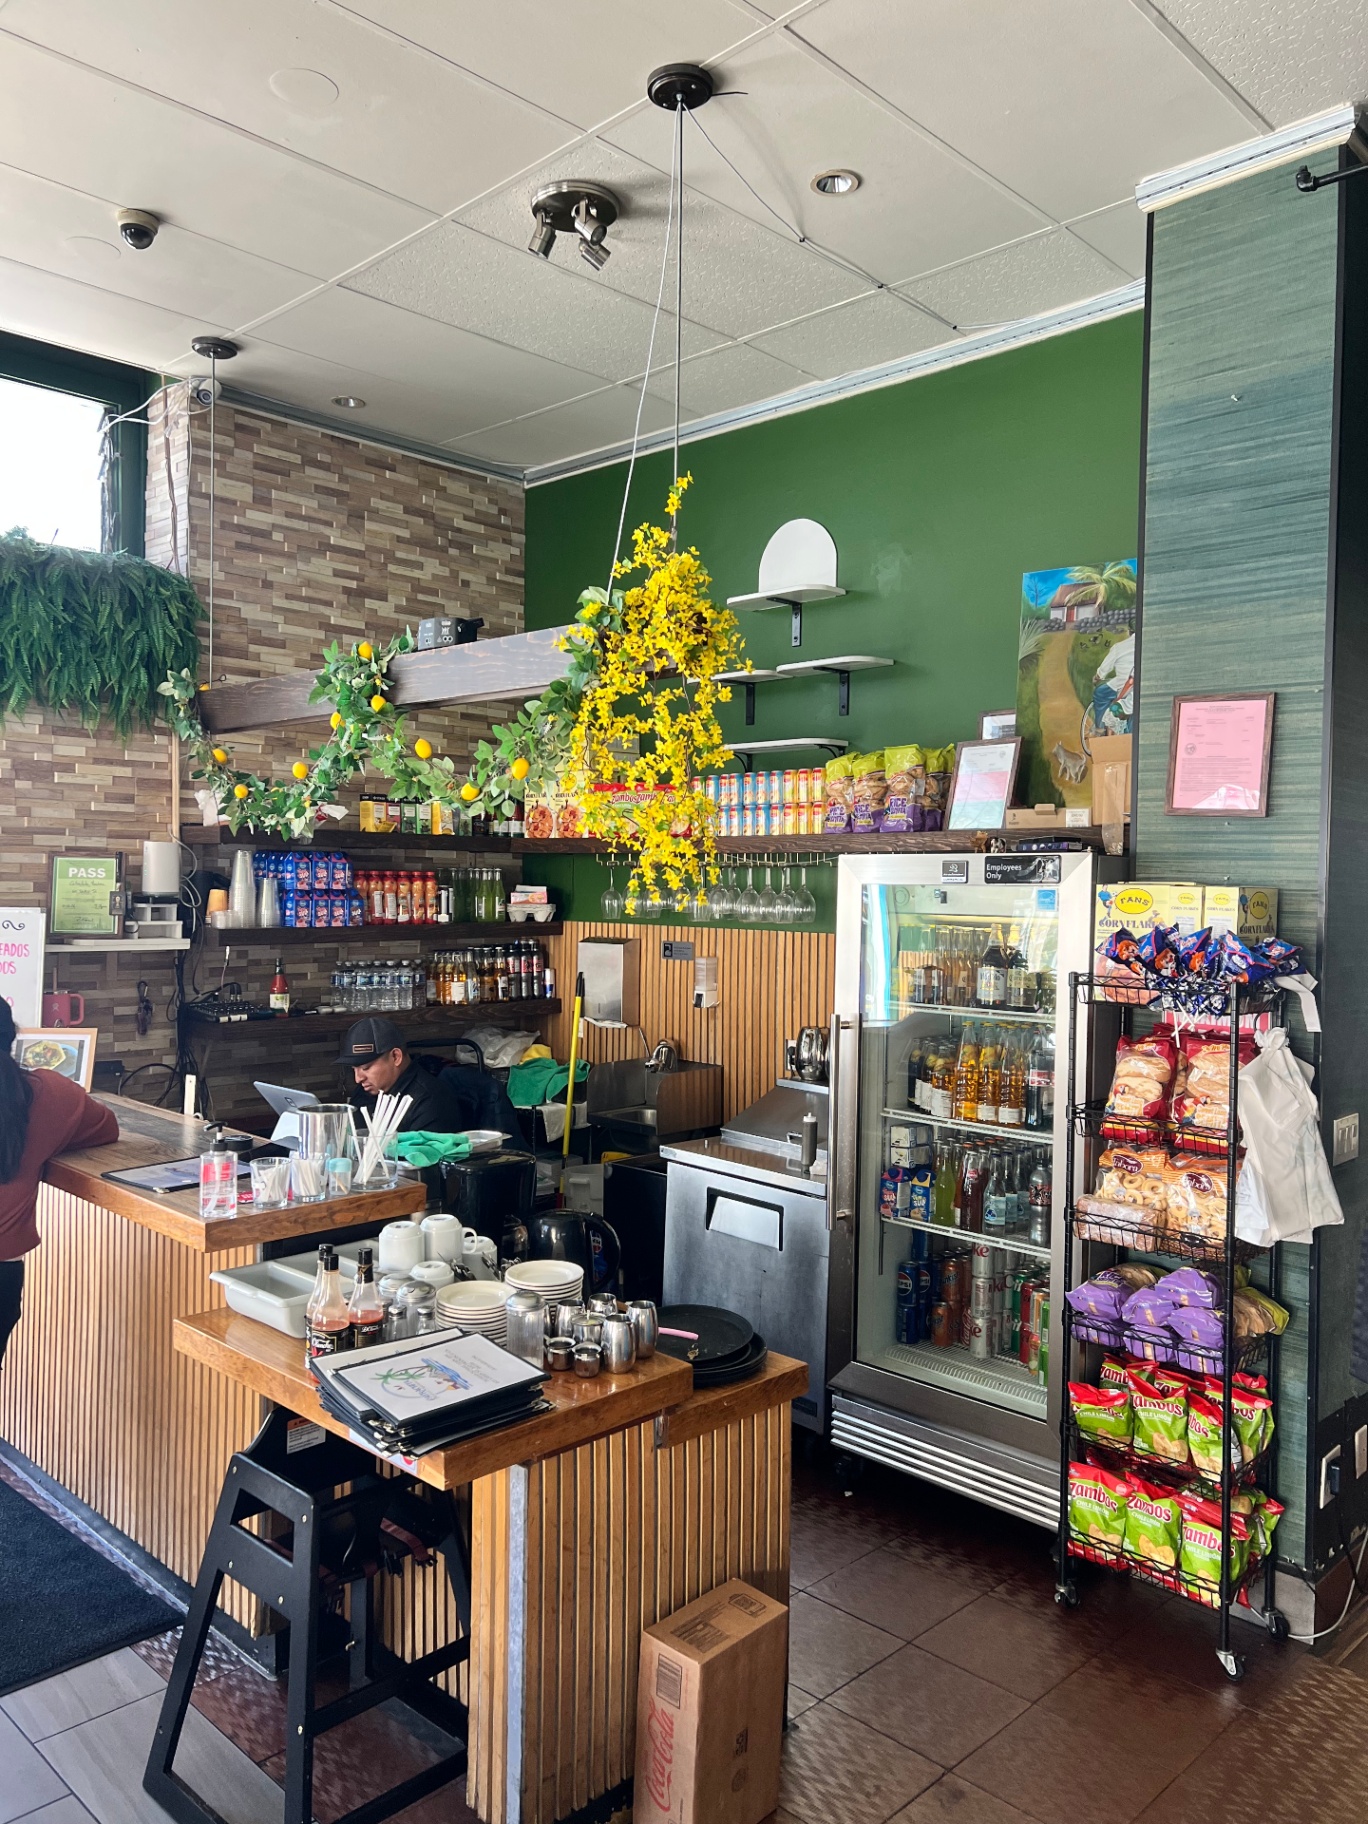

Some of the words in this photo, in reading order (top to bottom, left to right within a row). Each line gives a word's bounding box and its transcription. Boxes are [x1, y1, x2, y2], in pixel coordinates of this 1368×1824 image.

[986, 864, 1022, 872] Employees
[68, 867, 106, 878] PASS
[986, 872, 1002, 880] Only
